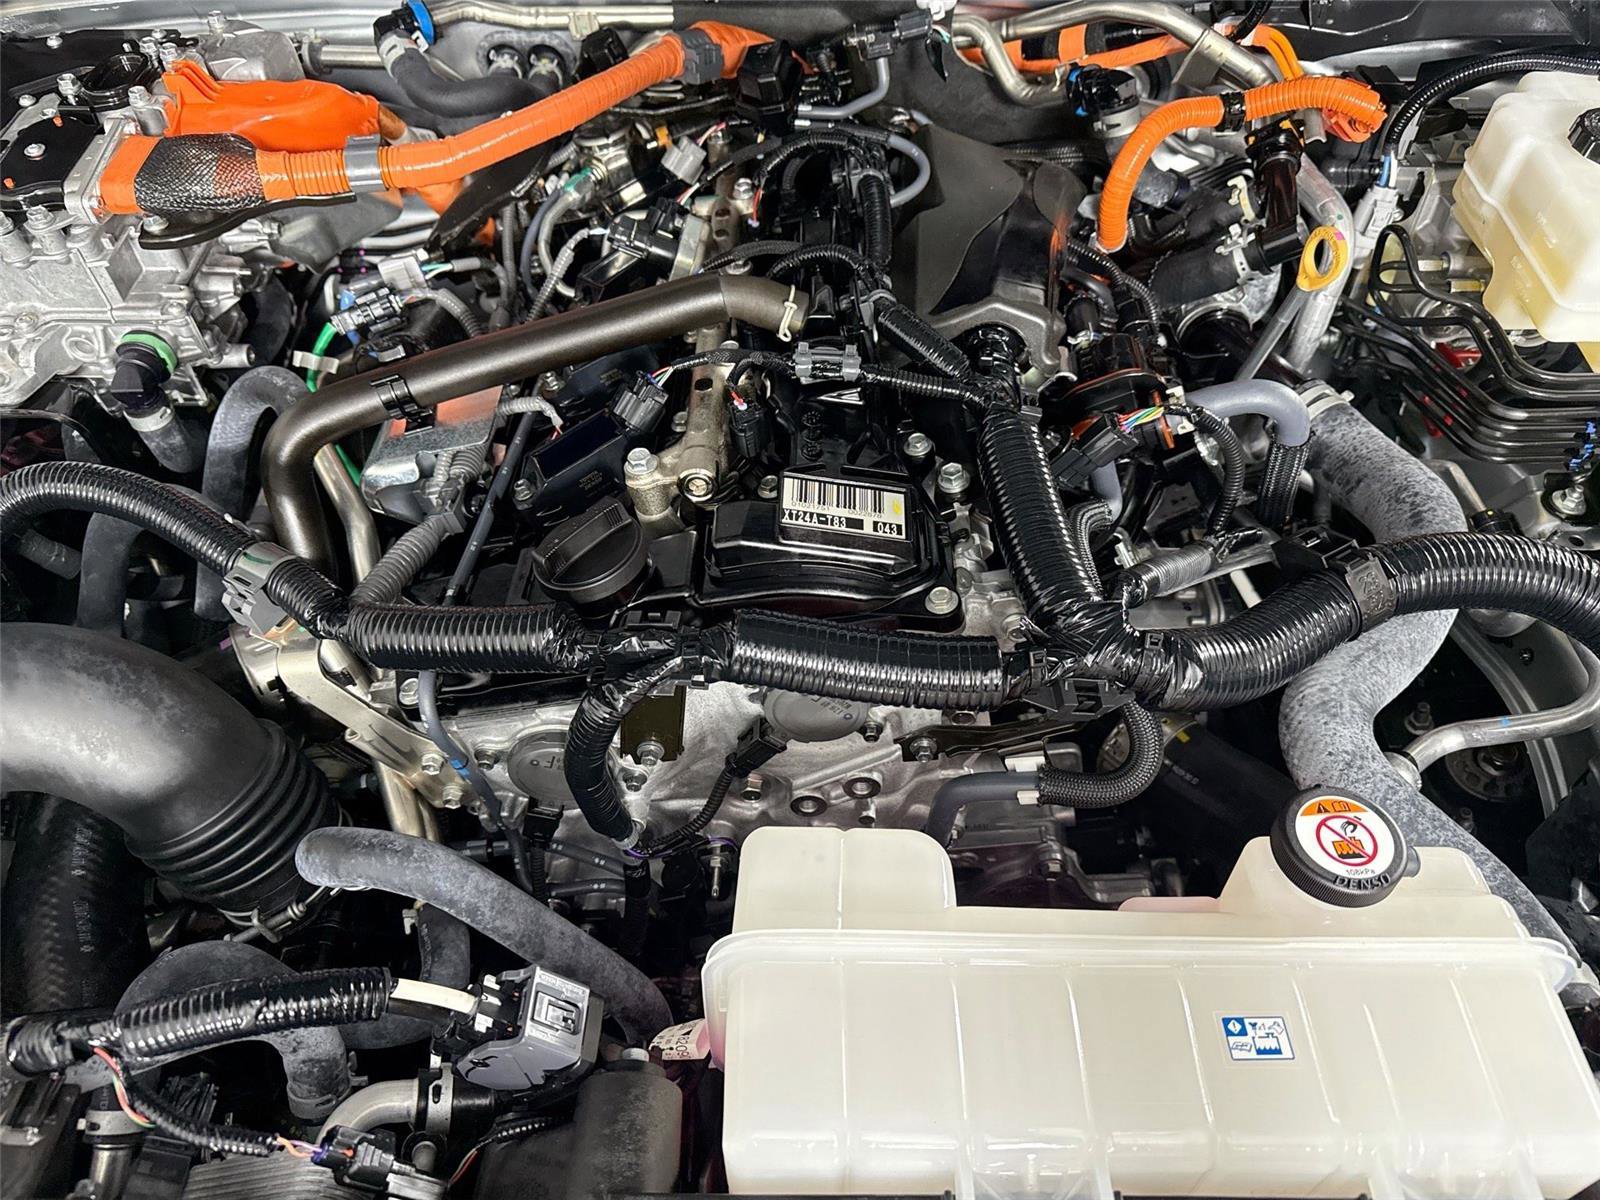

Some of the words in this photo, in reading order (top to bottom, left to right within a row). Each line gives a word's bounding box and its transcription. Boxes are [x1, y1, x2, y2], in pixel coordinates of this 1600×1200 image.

[783, 508, 847, 528] XT24A-T83
[877, 522, 897, 535] 043
[1334, 873, 1391, 890] DENSO
